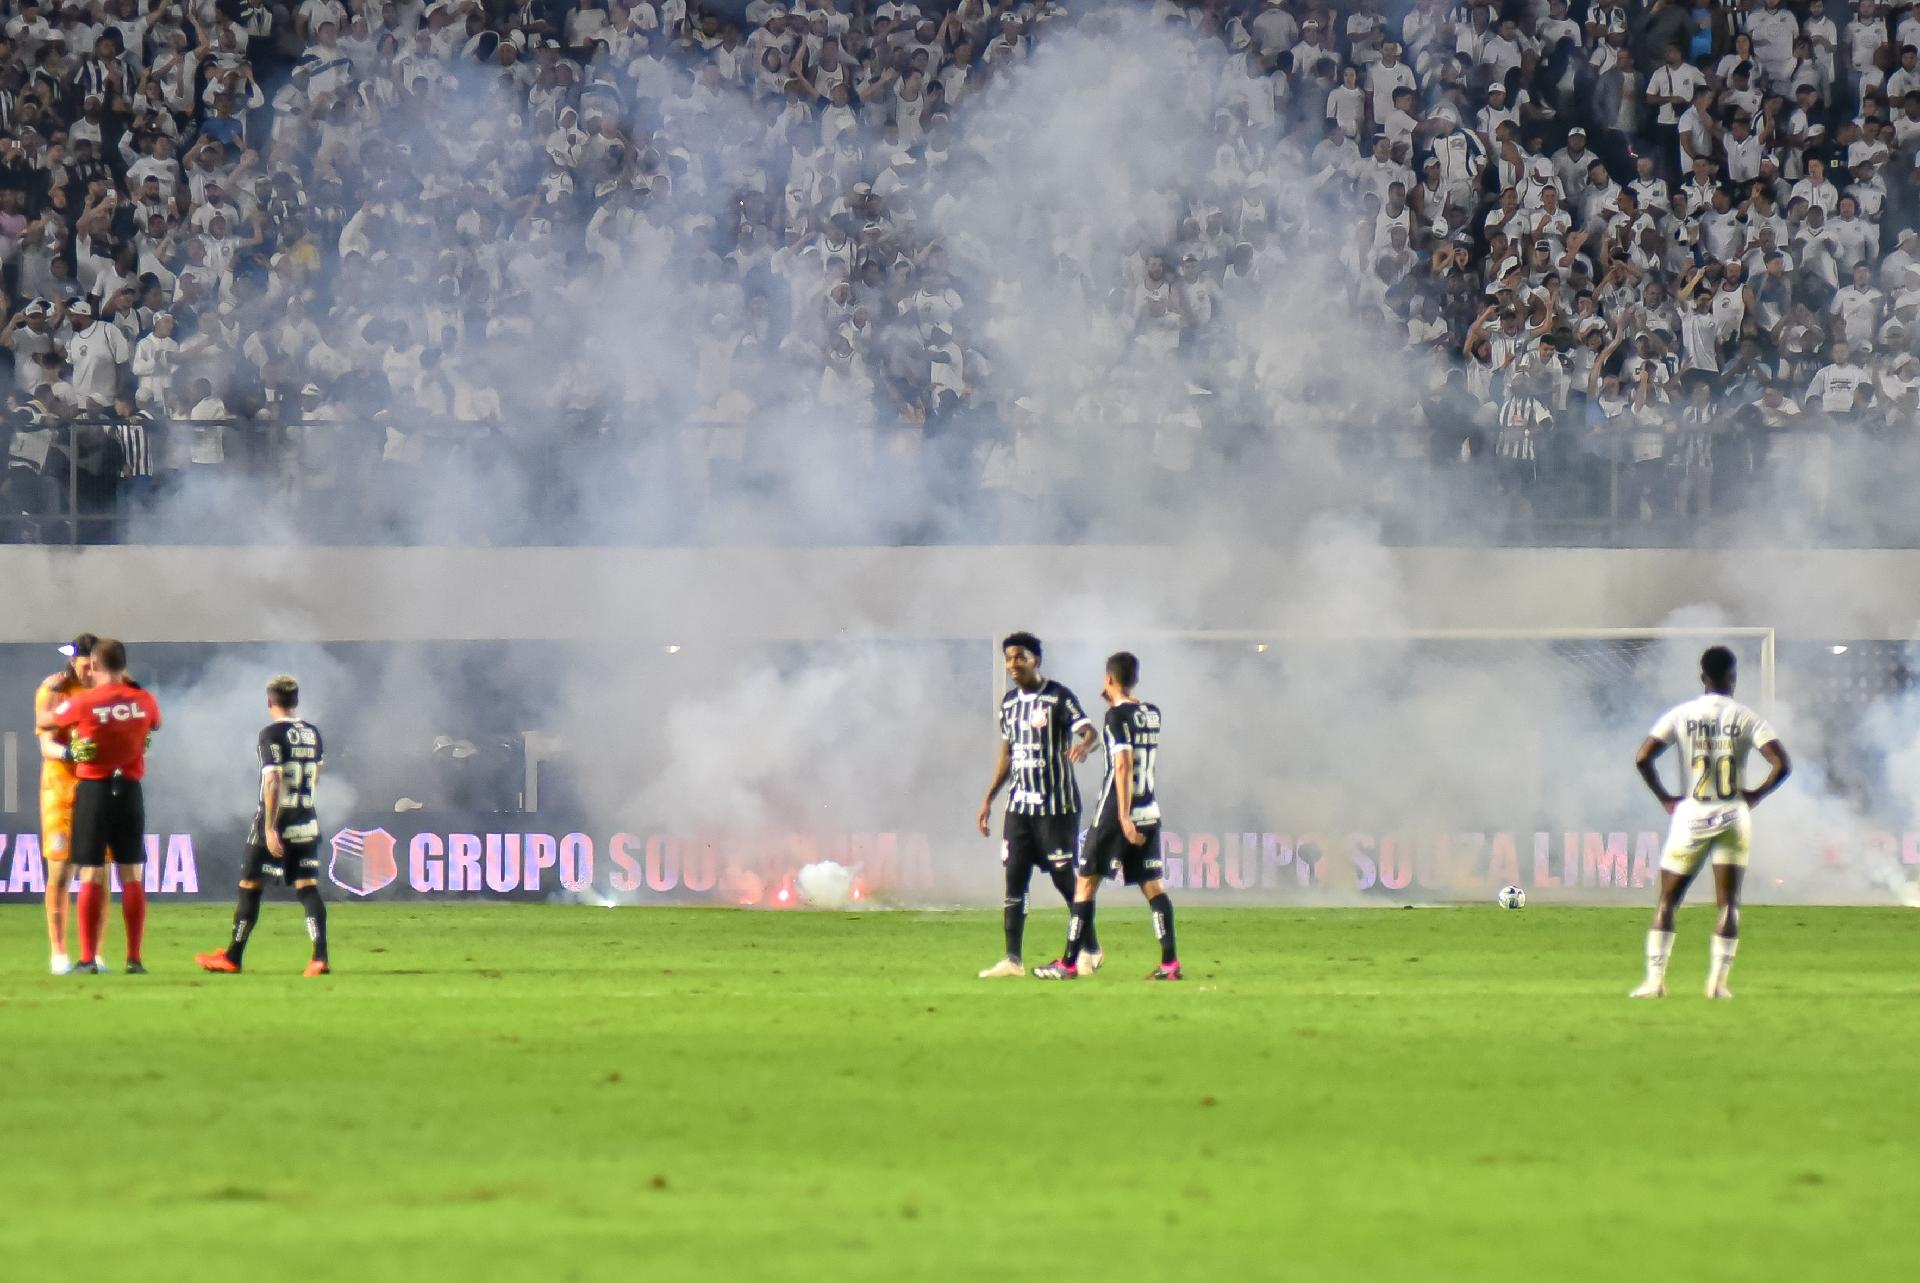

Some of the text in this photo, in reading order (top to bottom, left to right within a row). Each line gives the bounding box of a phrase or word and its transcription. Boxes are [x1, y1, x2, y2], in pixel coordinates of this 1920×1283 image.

[92, 702, 146, 724] TCL
[1686, 716, 1741, 738] Philco
[1691, 754, 1737, 801] 20
[409, 832, 594, 893] GRUPO
[1534, 831, 1662, 889] LIMA
